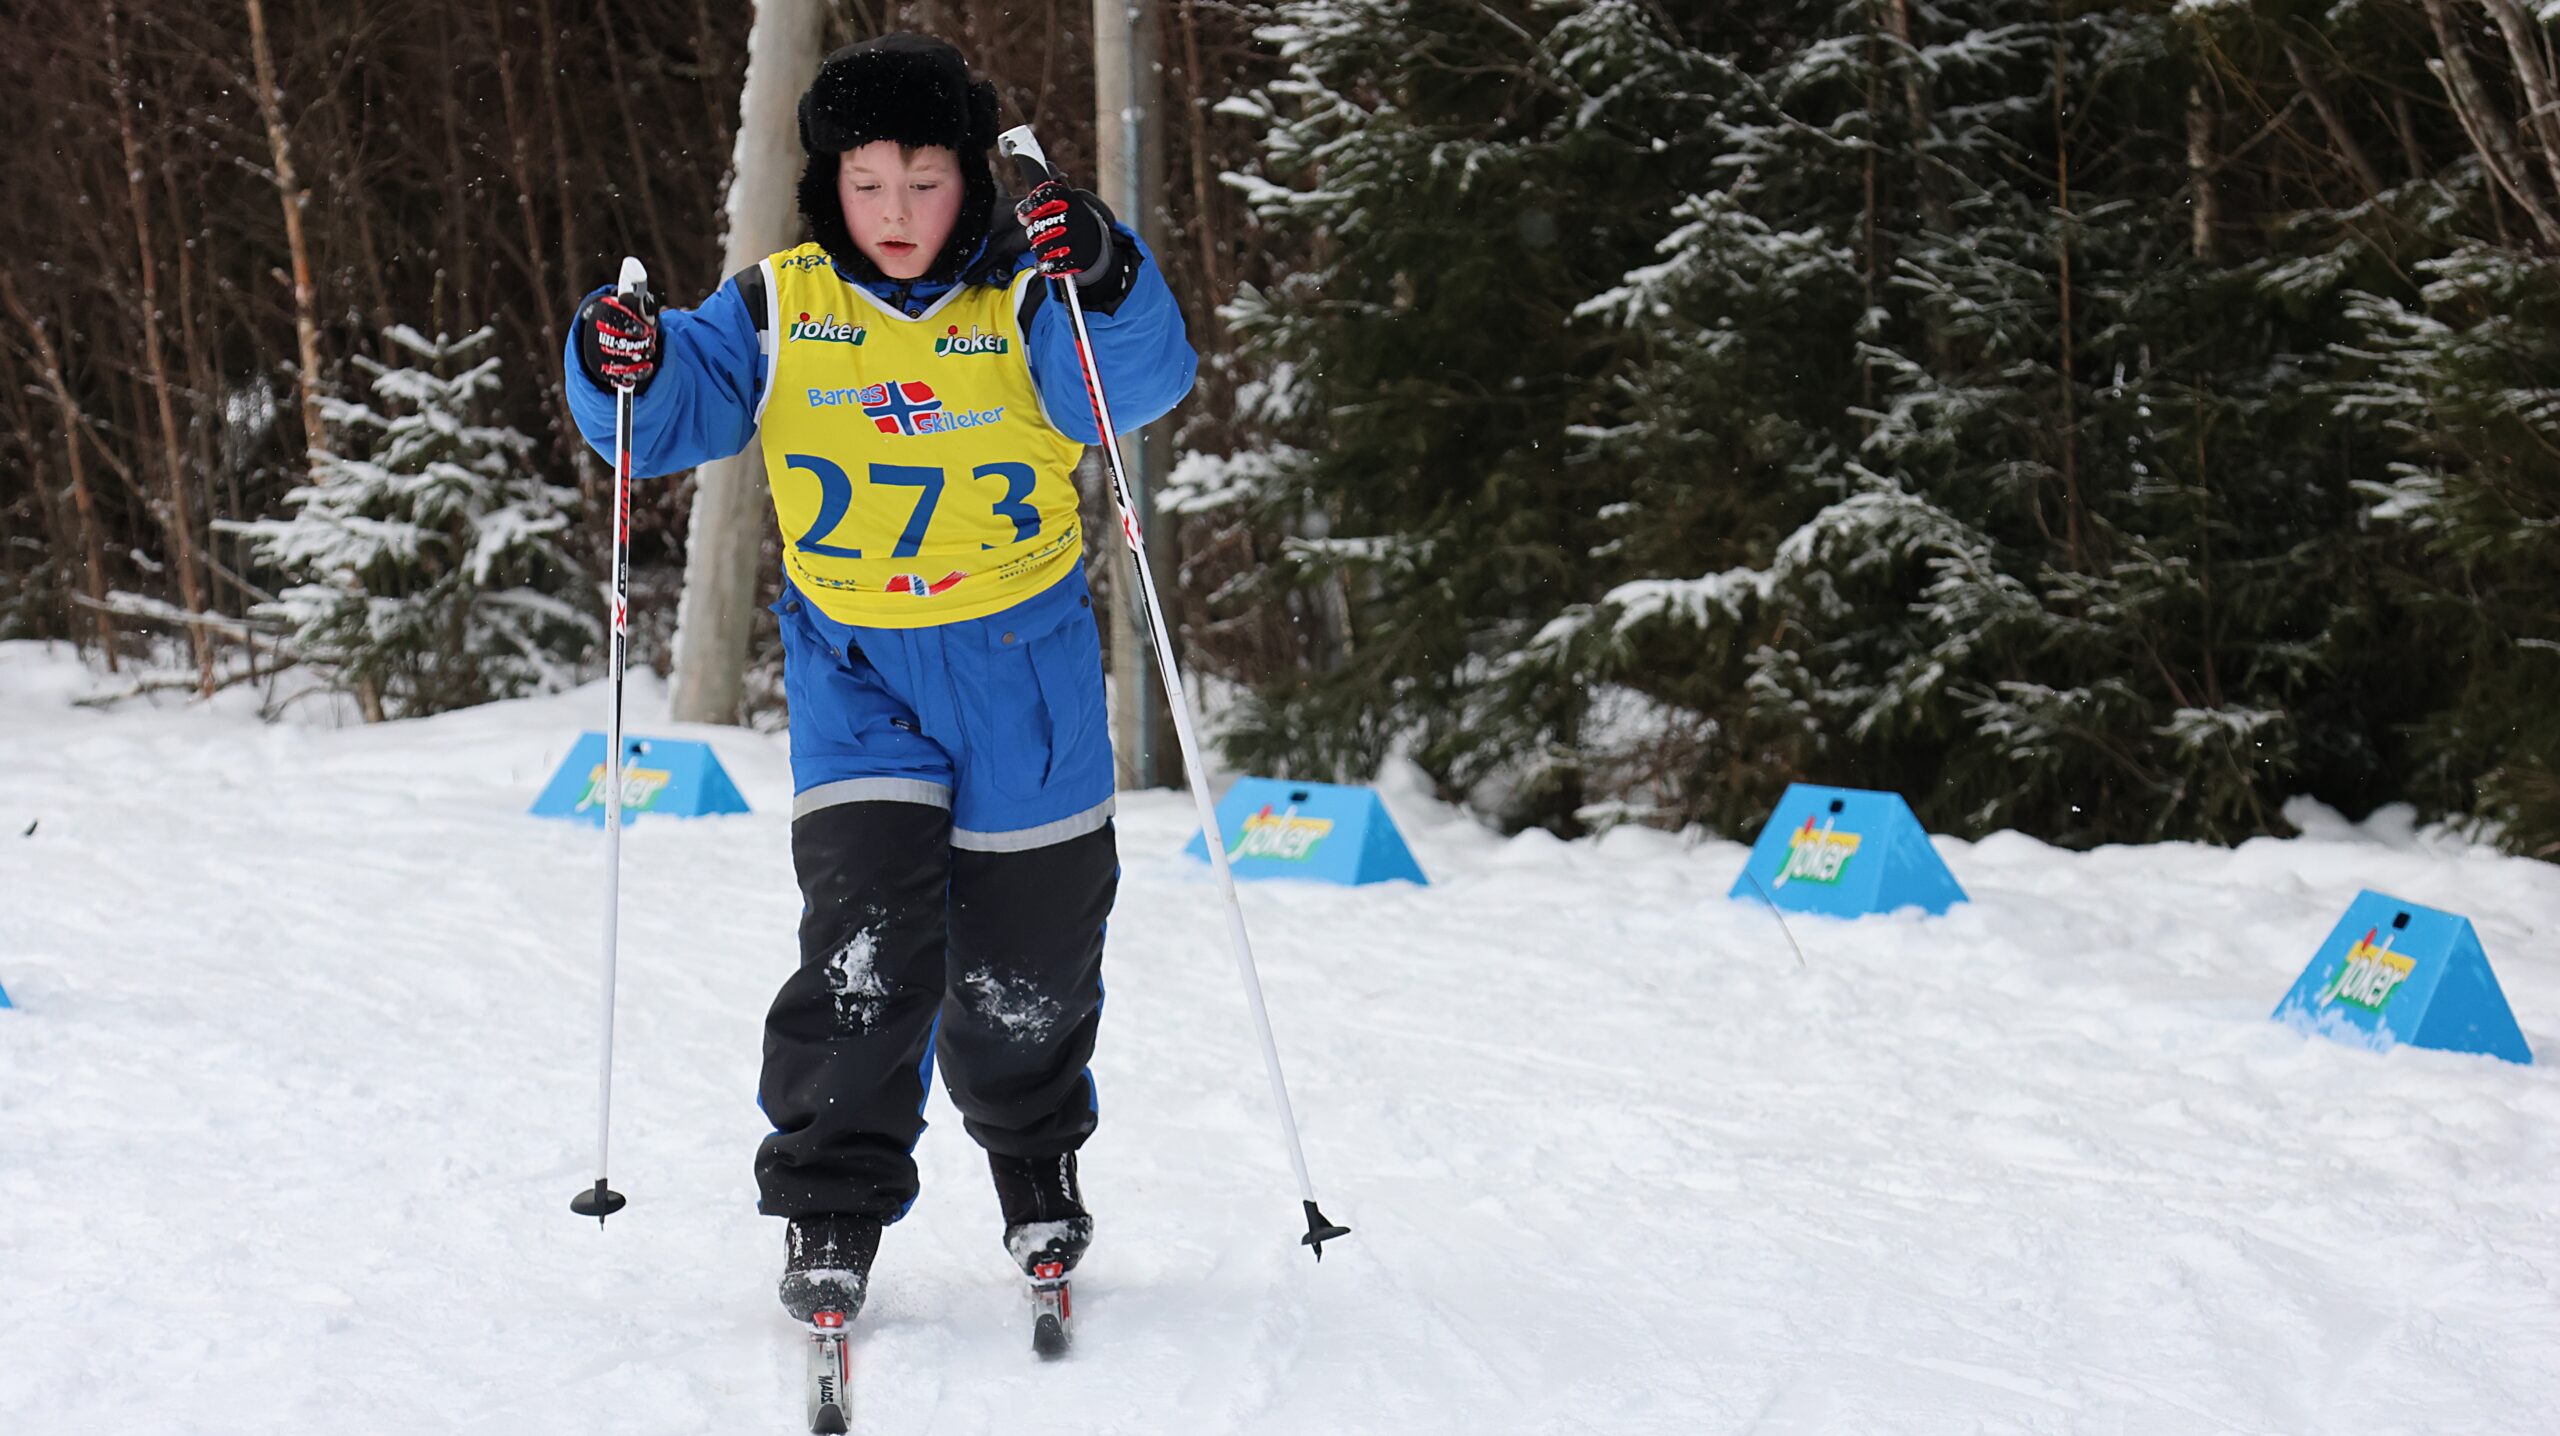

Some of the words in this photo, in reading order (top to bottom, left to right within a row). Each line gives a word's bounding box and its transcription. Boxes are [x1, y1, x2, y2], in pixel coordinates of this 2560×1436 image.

[789, 312, 863, 343] joker
[938, 325, 1003, 357] joker
[807, 386, 883, 408] Barnas
[784, 454, 1042, 560] 273
[1227, 804, 1320, 864] joker
[1773, 816, 1851, 889] joker
[2320, 927, 2404, 1009] joker
